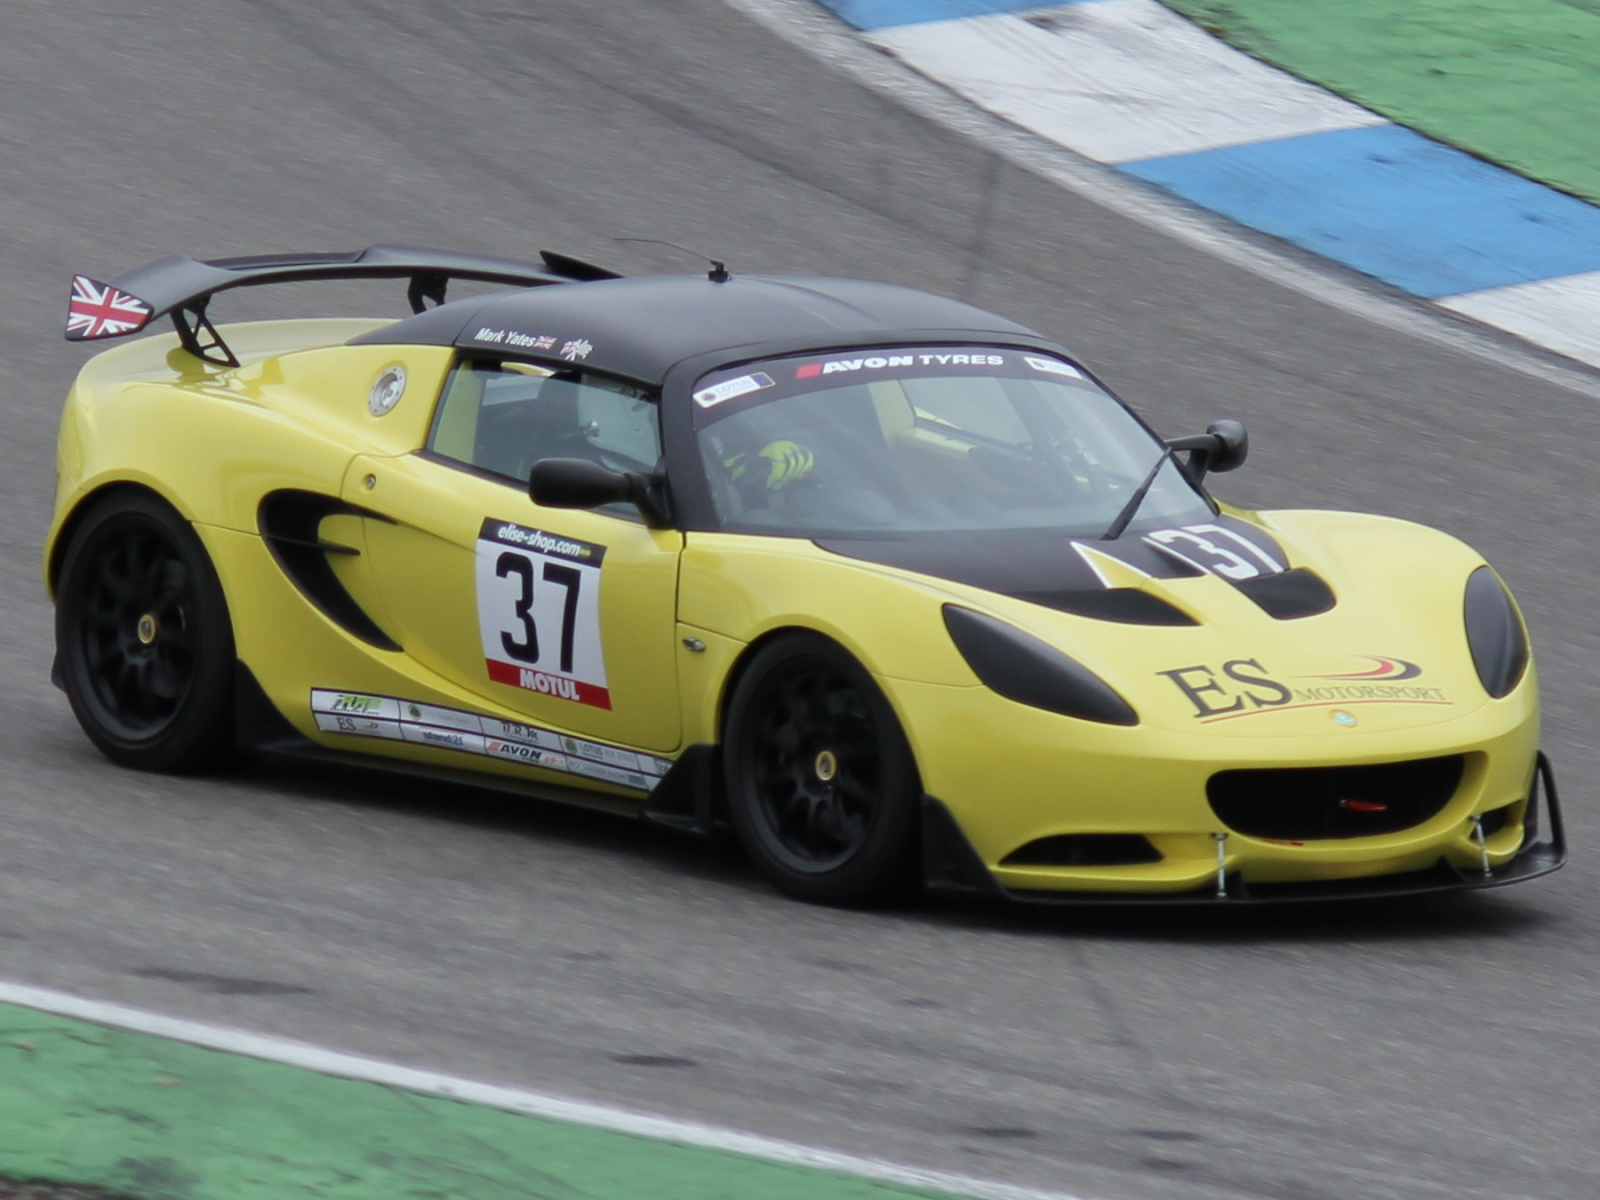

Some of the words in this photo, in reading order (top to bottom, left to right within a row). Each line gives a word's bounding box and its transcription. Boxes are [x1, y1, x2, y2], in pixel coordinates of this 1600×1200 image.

[474, 327, 505, 343] Mark
[505, 331, 537, 348] Yates
[822, 354, 913, 374] AVON
[918, 354, 1004, 366] TYRES
[498, 524, 580, 557] elise-shop.com
[1148, 524, 1285, 580] 37
[496, 551, 581, 674] 37
[520, 668, 580, 701] MOTUL
[1155, 658, 1293, 719] ES
[1293, 685, 1447, 702] MOTORSPORT
[336, 717, 356, 732] ES
[500, 744, 542, 759] AVON
